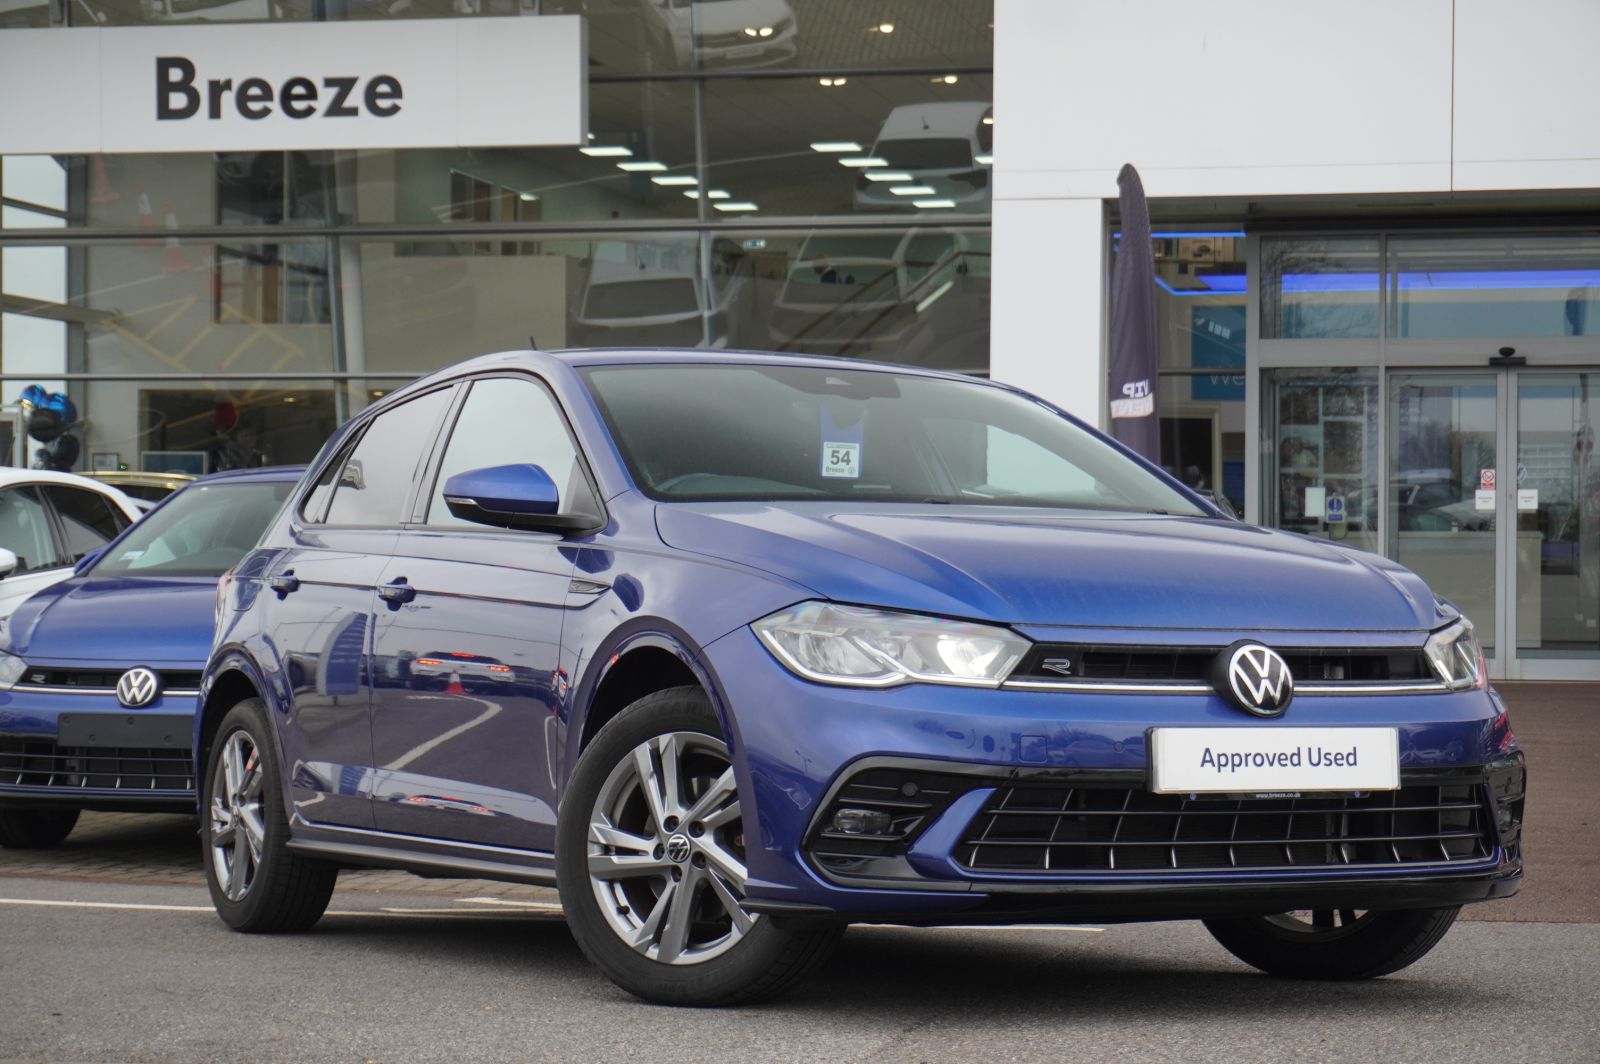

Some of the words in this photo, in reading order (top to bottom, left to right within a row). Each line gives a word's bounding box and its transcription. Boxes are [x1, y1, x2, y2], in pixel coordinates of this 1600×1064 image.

[156, 56, 403, 121] Breeze
[830, 449, 852, 466] 54
[1200, 746, 1302, 773] Approved
[1307, 746, 1358, 768] Used
